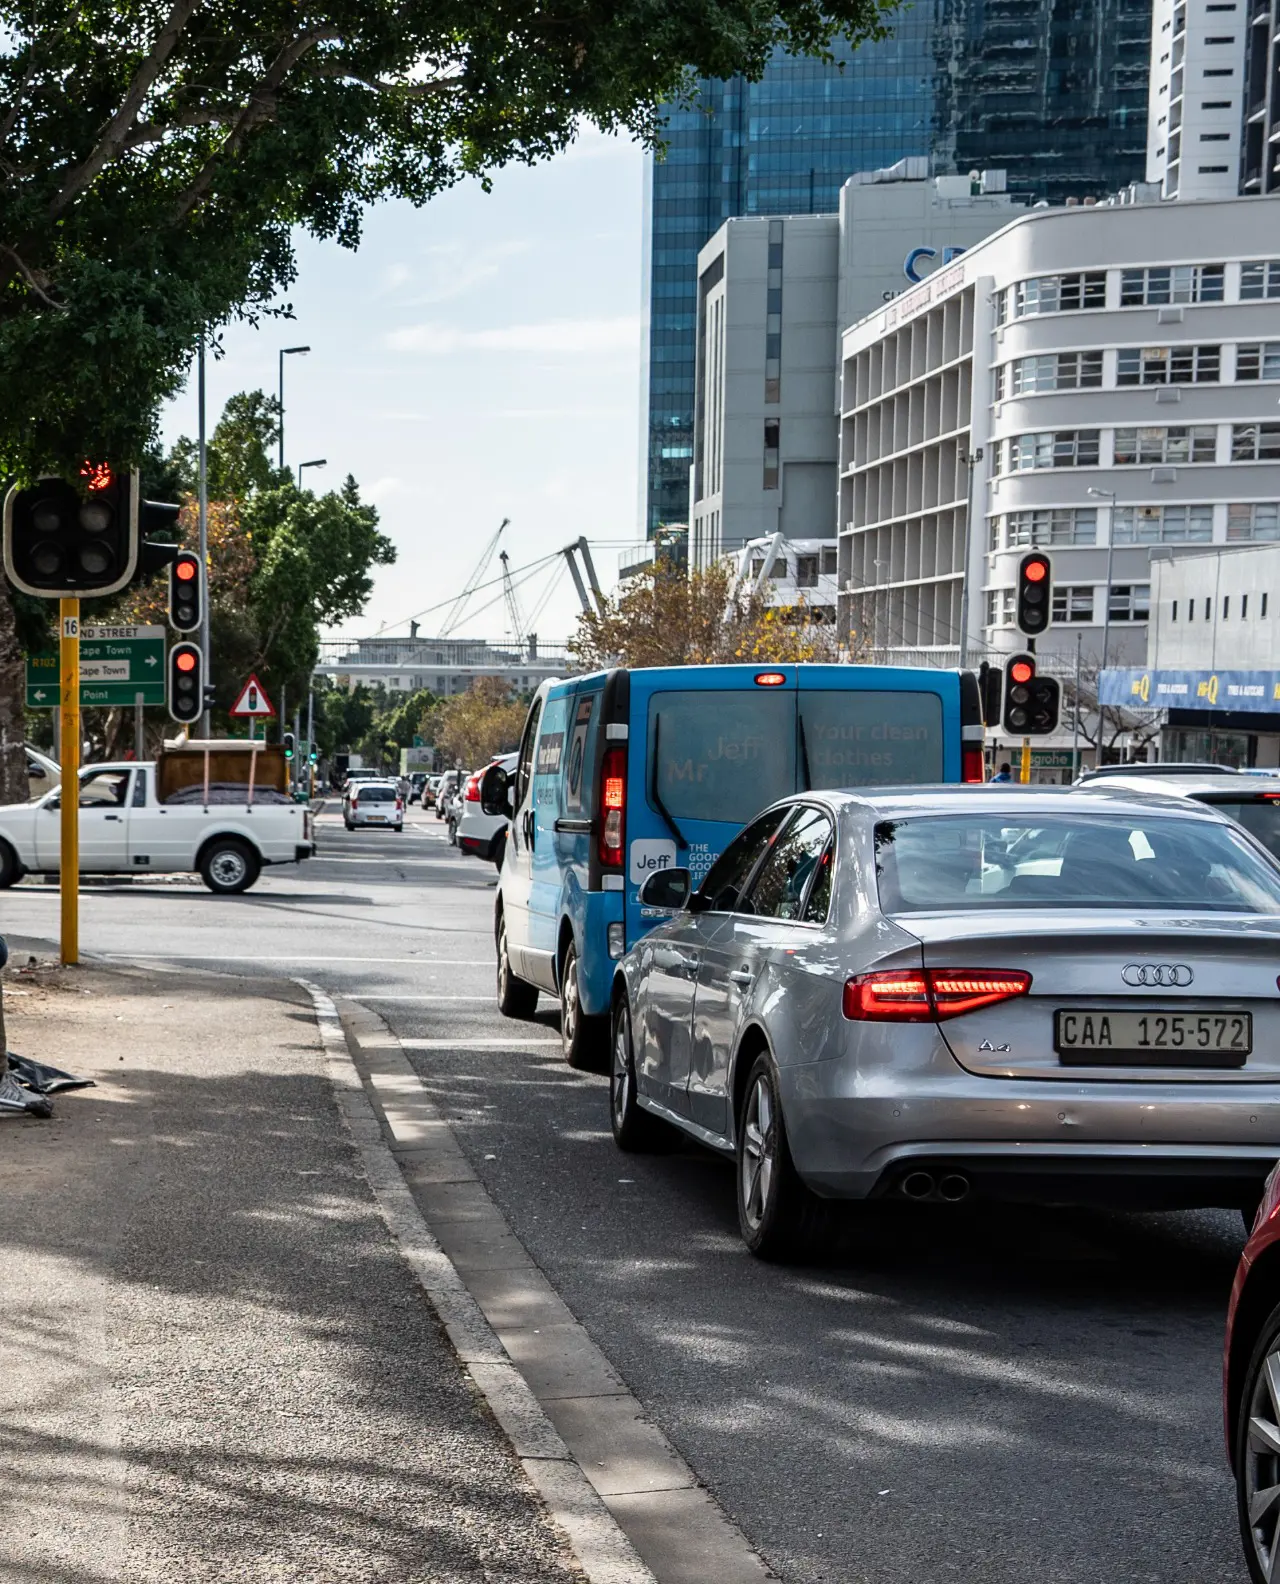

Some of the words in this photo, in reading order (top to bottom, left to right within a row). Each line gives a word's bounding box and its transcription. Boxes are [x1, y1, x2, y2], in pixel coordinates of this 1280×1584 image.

[65, 620, 77, 634] 16
[100, 628, 138, 638] STREET
[106, 645, 132, 654] Town
[102, 665, 126, 675] Town
[83, 690, 108, 700] Point
[813, 723, 866, 741] Your
[871, 720, 928, 741] clean
[667, 758, 708, 784] Mr
[708, 735, 763, 761] Jeff
[813, 746, 893, 767] clothes
[689, 843, 709, 852] THE
[637, 854, 671, 869] Jeff
[689, 862, 713, 871] GOO
[1064, 1016, 1112, 1045] CAA
[1138, 1017, 1243, 1047] 125-572
[976, 1039, 1011, 1053] A4
